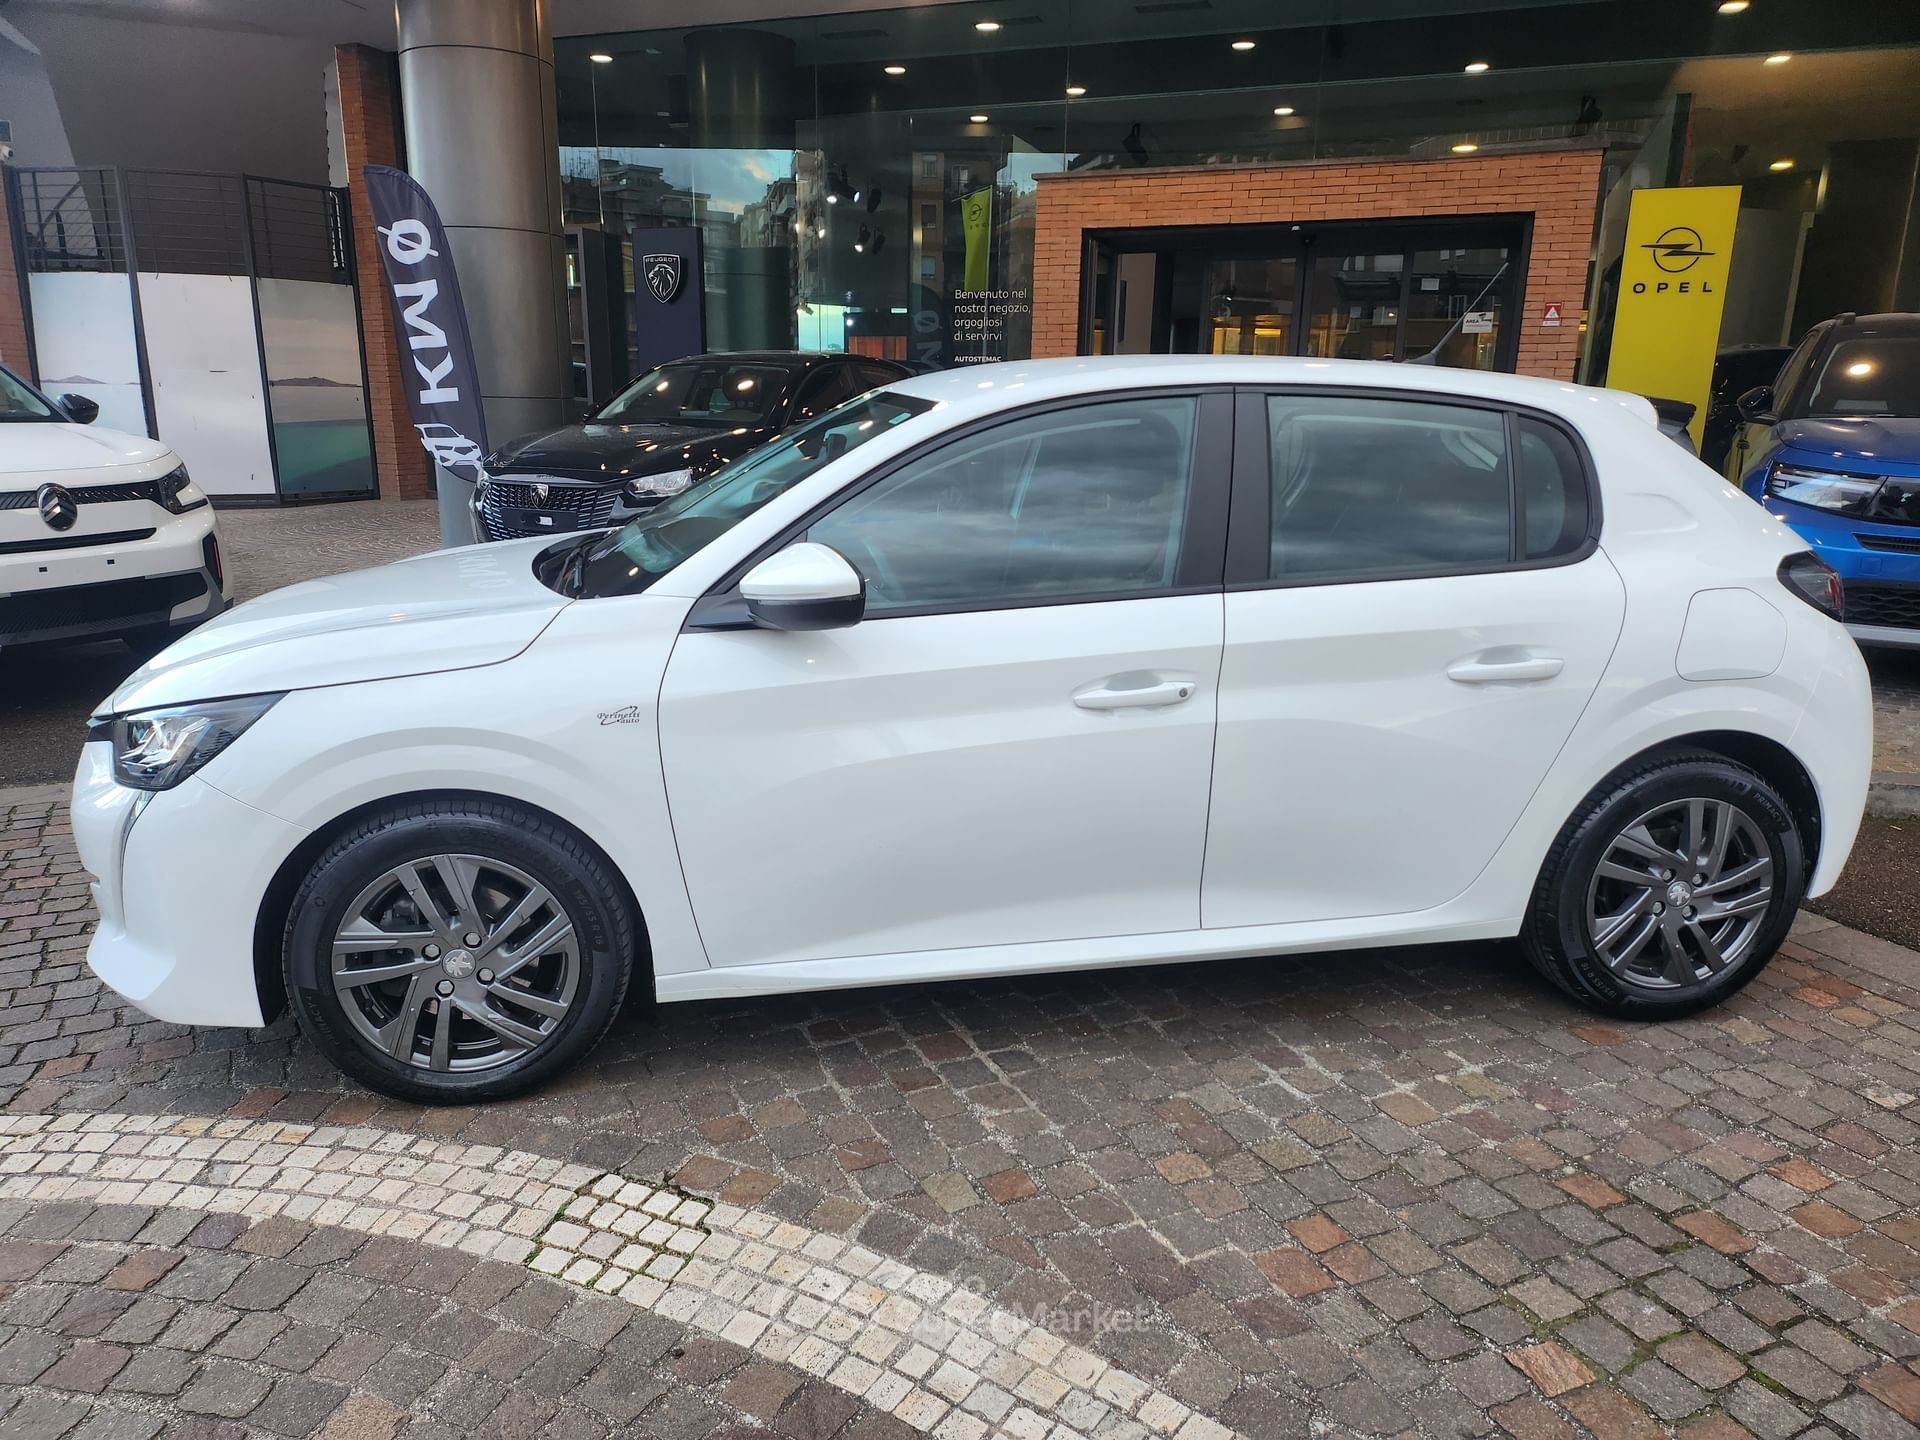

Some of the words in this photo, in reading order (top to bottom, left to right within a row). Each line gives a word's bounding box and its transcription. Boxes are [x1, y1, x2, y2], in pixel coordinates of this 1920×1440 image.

[954, 289, 1009, 299] Benvenuto
[1011, 288, 1027, 298] nel
[1633, 282, 1713, 294] OPEL
[954, 304, 987, 313] nostro
[989, 303, 1031, 315] negozio,
[954, 317, 1003, 329] orgogliosi
[953, 331, 963, 341] di
[965, 331, 1002, 341] servirvi
